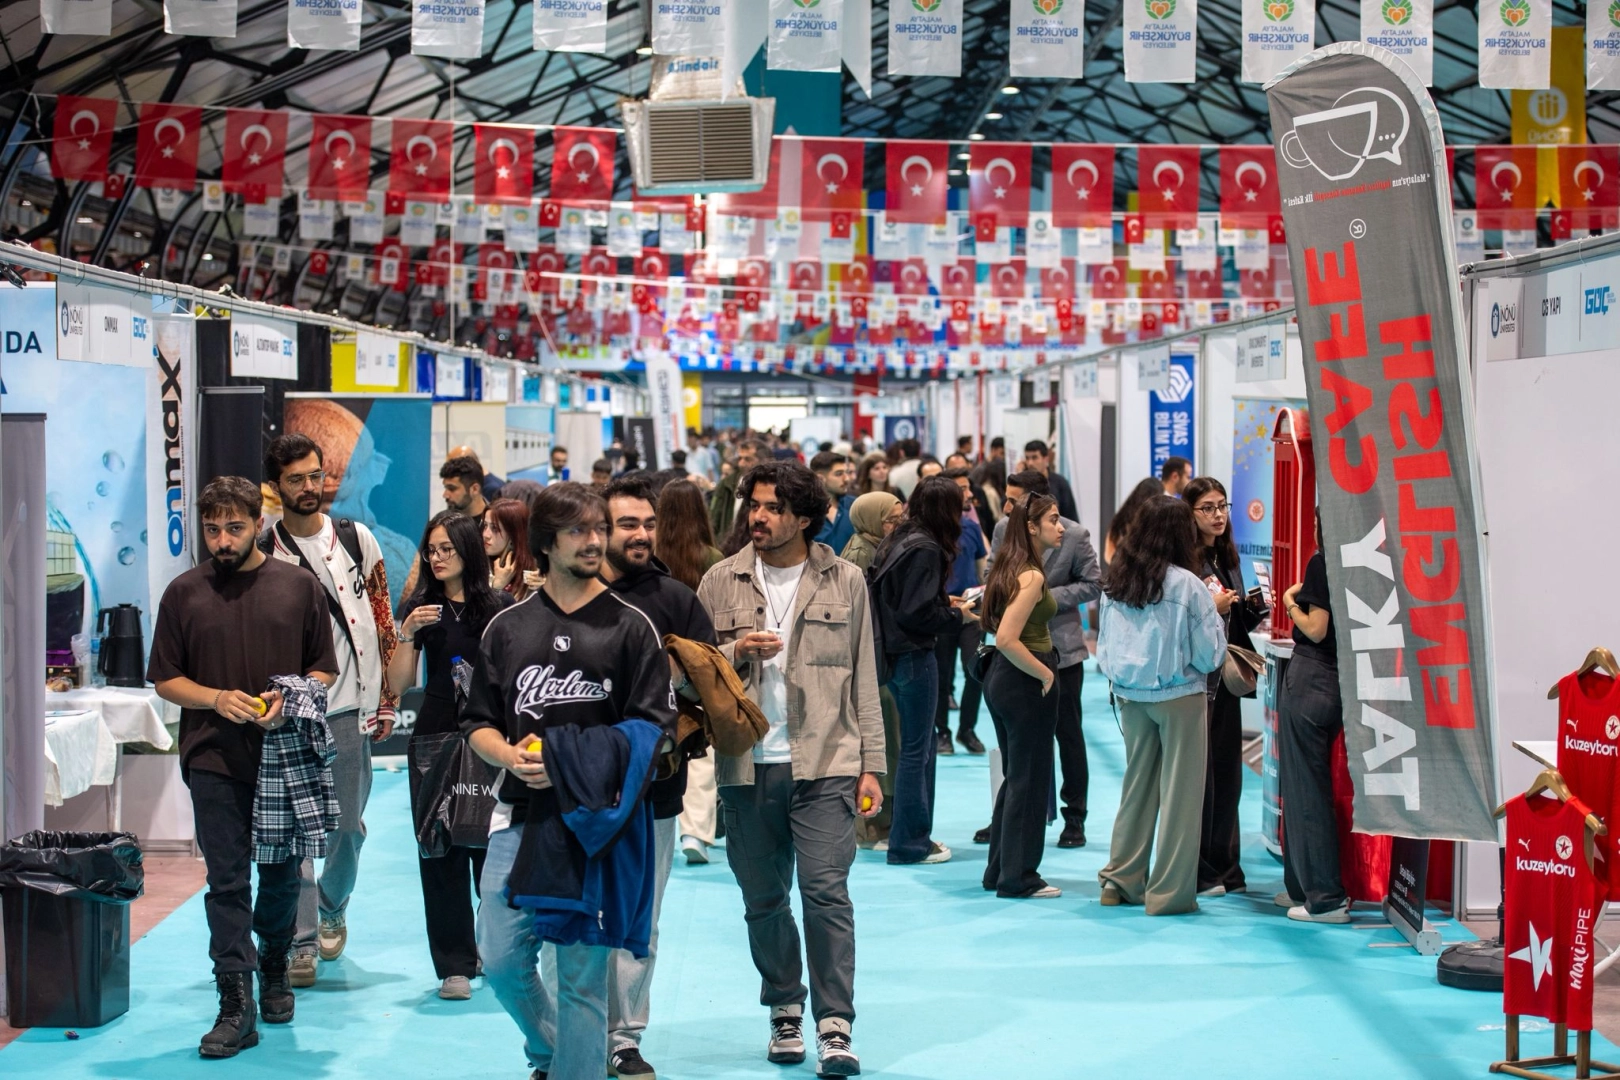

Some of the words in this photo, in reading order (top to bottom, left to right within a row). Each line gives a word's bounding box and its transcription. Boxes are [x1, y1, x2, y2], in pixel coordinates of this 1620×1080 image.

[0, 331, 42, 353] DA
[1154, 411, 1172, 445] BİLİM
[1173, 411, 1191, 445] SİVAS
[153, 344, 184, 557] onmax
[1154, 445, 1170, 462] VE
[1238, 541, 1273, 557] ALİTEMİZ
[515, 664, 609, 720] Harlem
[452, 783, 479, 797] NINE
[1516, 856, 1576, 878] kuzeyboru
